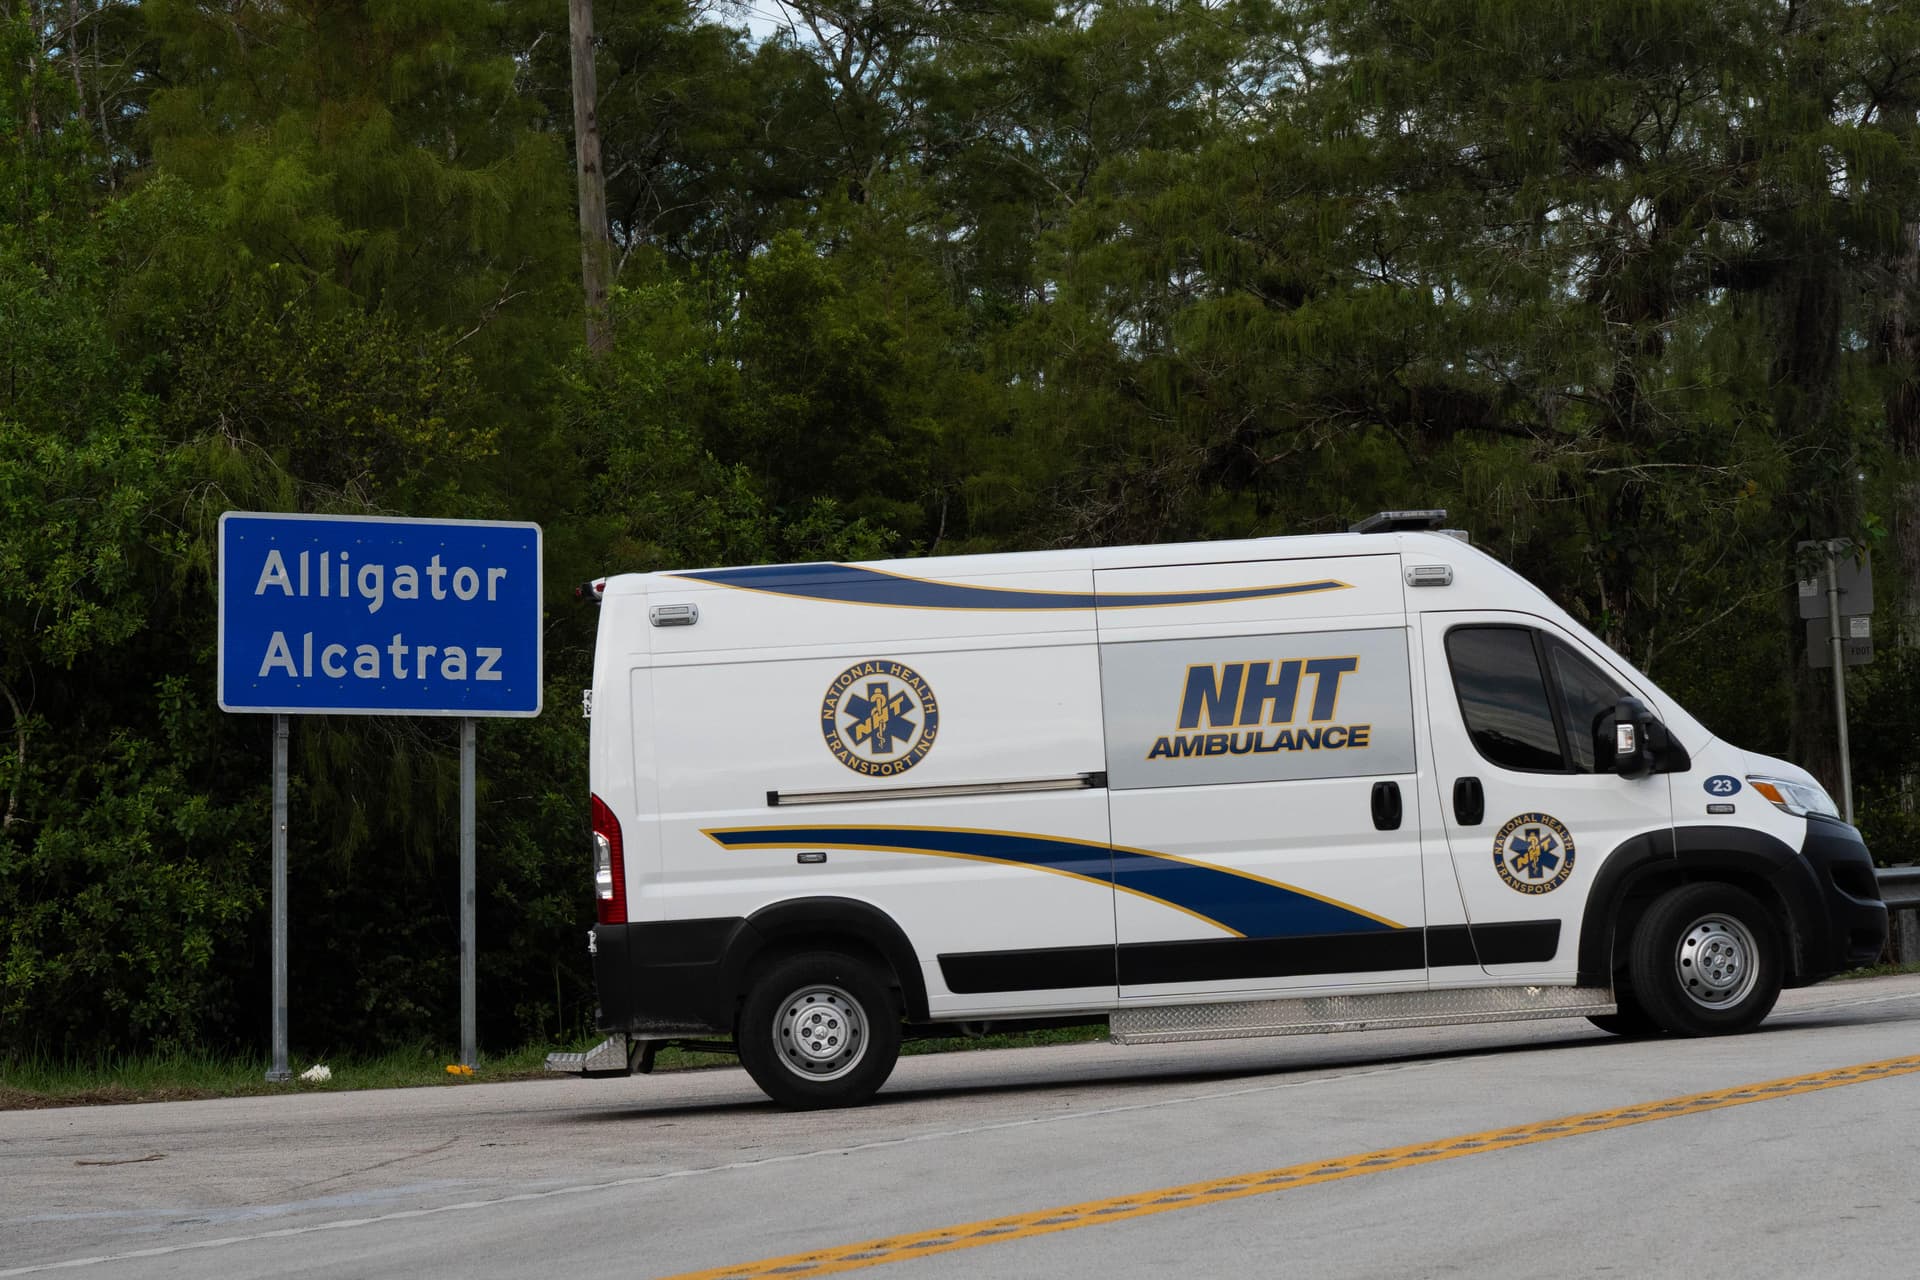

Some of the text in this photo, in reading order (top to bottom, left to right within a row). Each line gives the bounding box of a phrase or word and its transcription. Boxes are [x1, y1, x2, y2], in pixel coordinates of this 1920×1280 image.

[254, 549, 507, 615] Alligator
[258, 631, 502, 681] Alcatraz
[823, 661, 937, 720] NATIONAL HEALTH
[1175, 655, 1361, 731] NHT
[855, 695, 904, 741] NHT
[826, 725, 937, 774] TRANSPORT INC.
[1146, 724, 1371, 760] AMBULANCE
[1712, 779, 1732, 792] 23
[1495, 815, 1574, 854] NATIONAL HEALTH
[1496, 858, 1574, 895] TRANSPORT INC.
